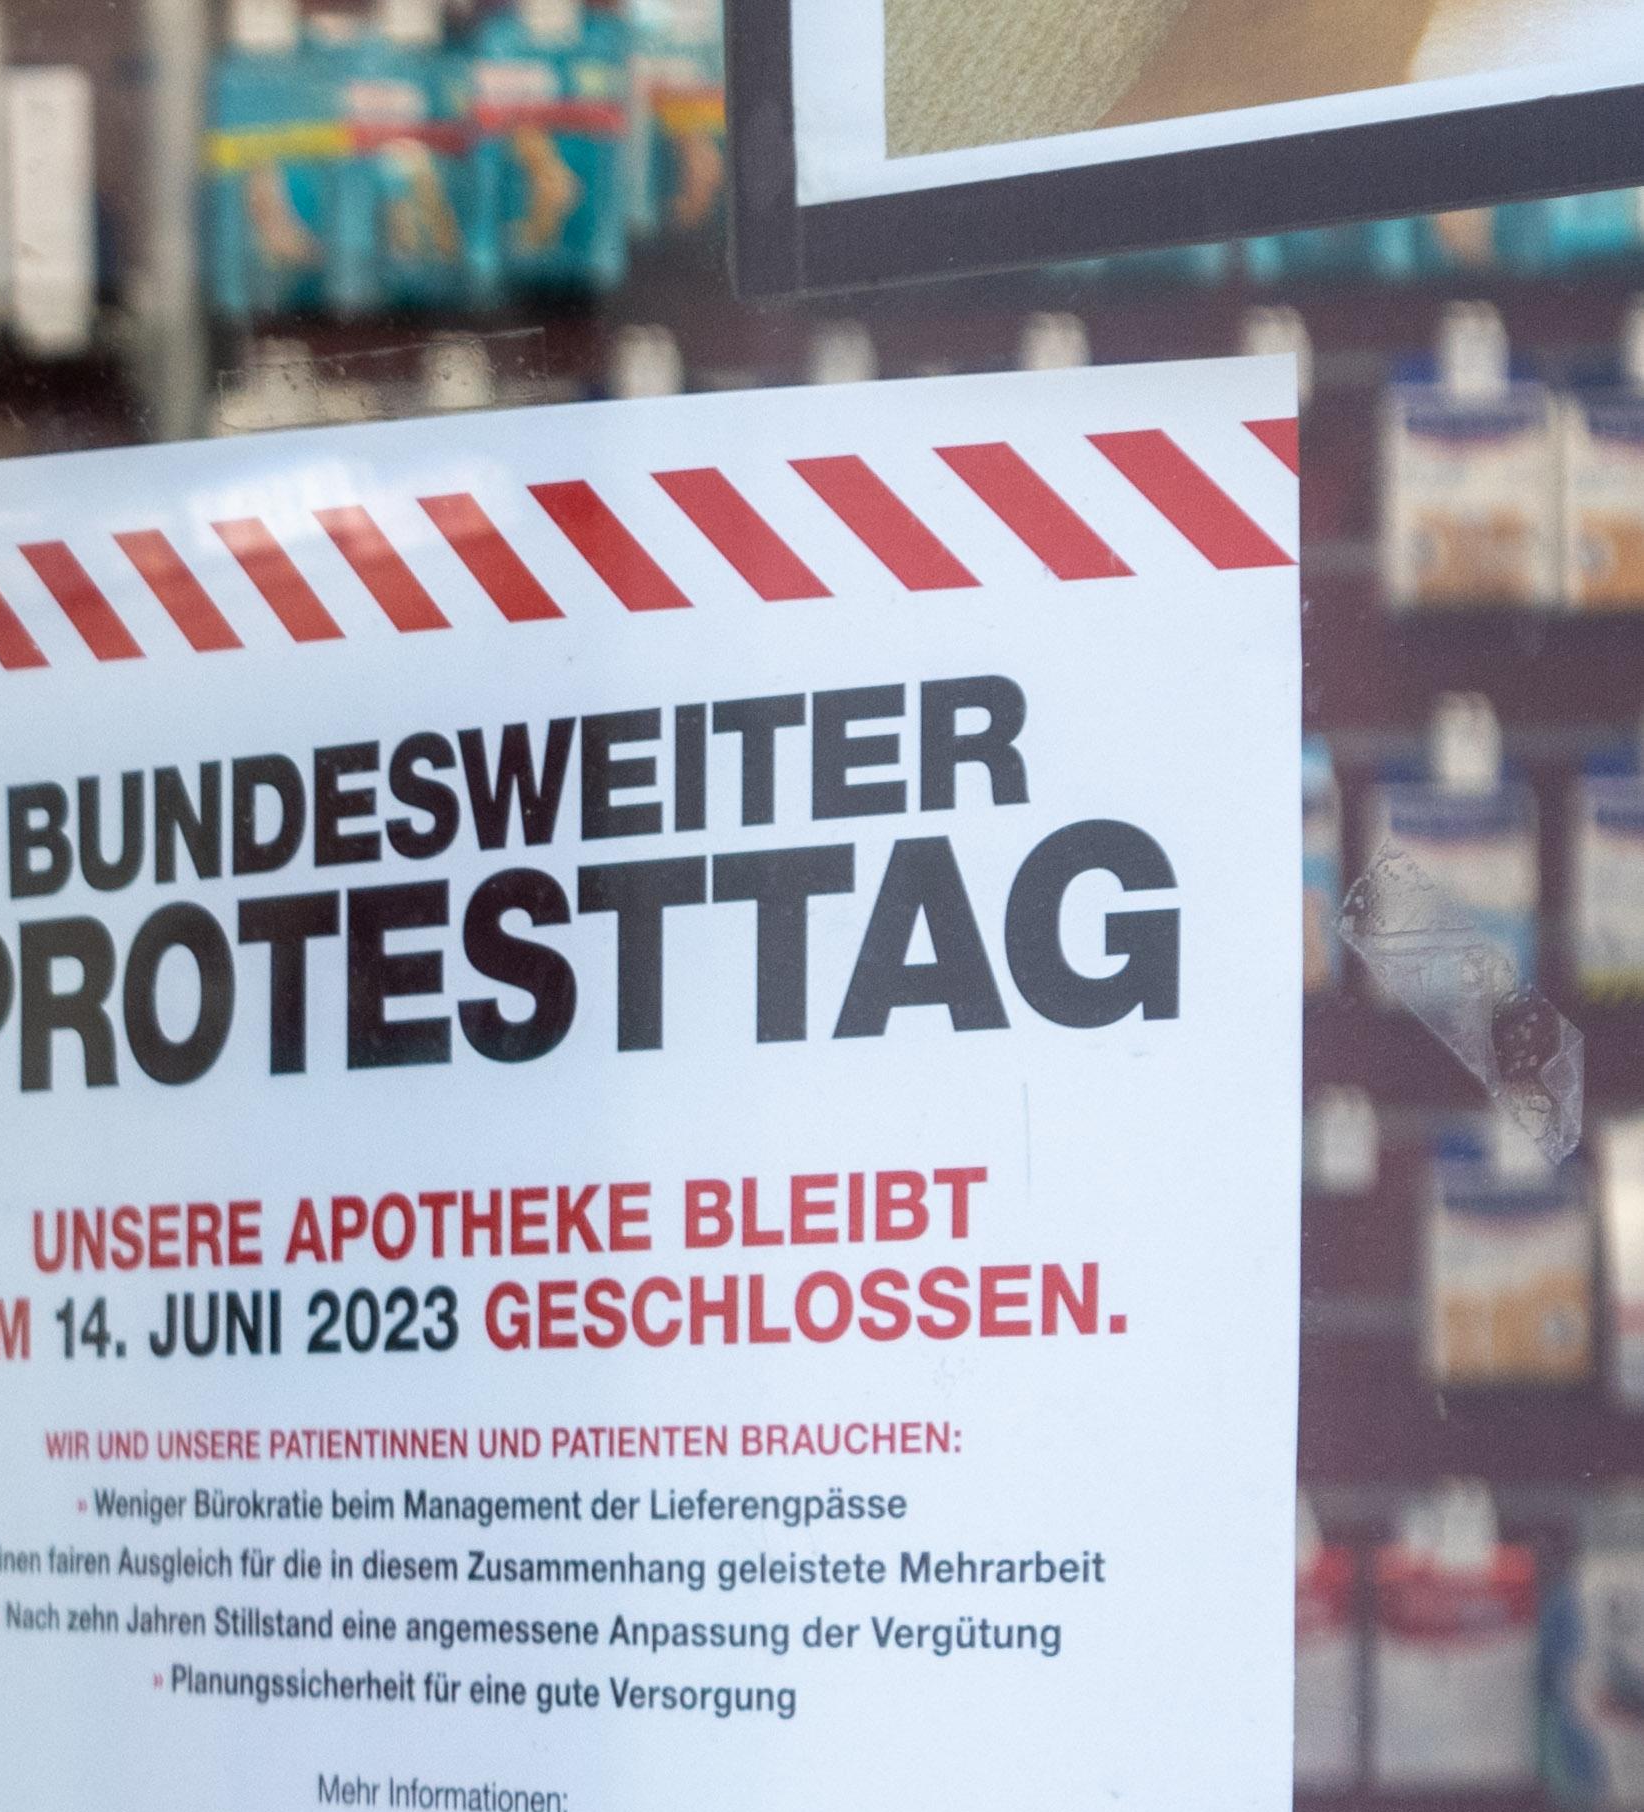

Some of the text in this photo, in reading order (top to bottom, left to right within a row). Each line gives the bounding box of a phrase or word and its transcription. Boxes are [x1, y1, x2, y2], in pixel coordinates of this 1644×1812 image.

[7, 674, 1031, 901] BUNDESWEITER
[34, 1167, 987, 1273] UNSERE APOTHEKE BLEIBT
[56, 1297, 126, 1359] 14.
[150, 1290, 281, 1357] JUNI
[307, 1286, 458, 1354] 2023
[484, 1263, 1126, 1351] GESCHLOSSEN.
[46, 1422, 960, 1460] WIR UND UNSERE PATIENTINNEN UND PATIENTEN BRAUCHEN:
[94, 1488, 907, 1527] Weniger Bürokratie beim Management der Lieferengpässe
[48, 1547, 110, 1575] fairen
[118, 1547, 232, 1584] Ausgleich
[240, 1549, 275, 1578] für
[283, 1549, 321, 1579] die
[331, 1550, 353, 1578] in
[362, 1550, 458, 1580] diesem
[467, 1550, 704, 1591] Zusammenhang
[718, 1552, 886, 1591] geleistete
[901, 1551, 1105, 1583] Mehrarbeit
[6, 1601, 1061, 1657] Nach zehn Jahren Stillstand eine angemessene Anpassung der Vergütung
[171, 1664, 795, 1719] Planungssicherheit für eine gute Versorgung
[318, 1774, 380, 1805] Mehr
